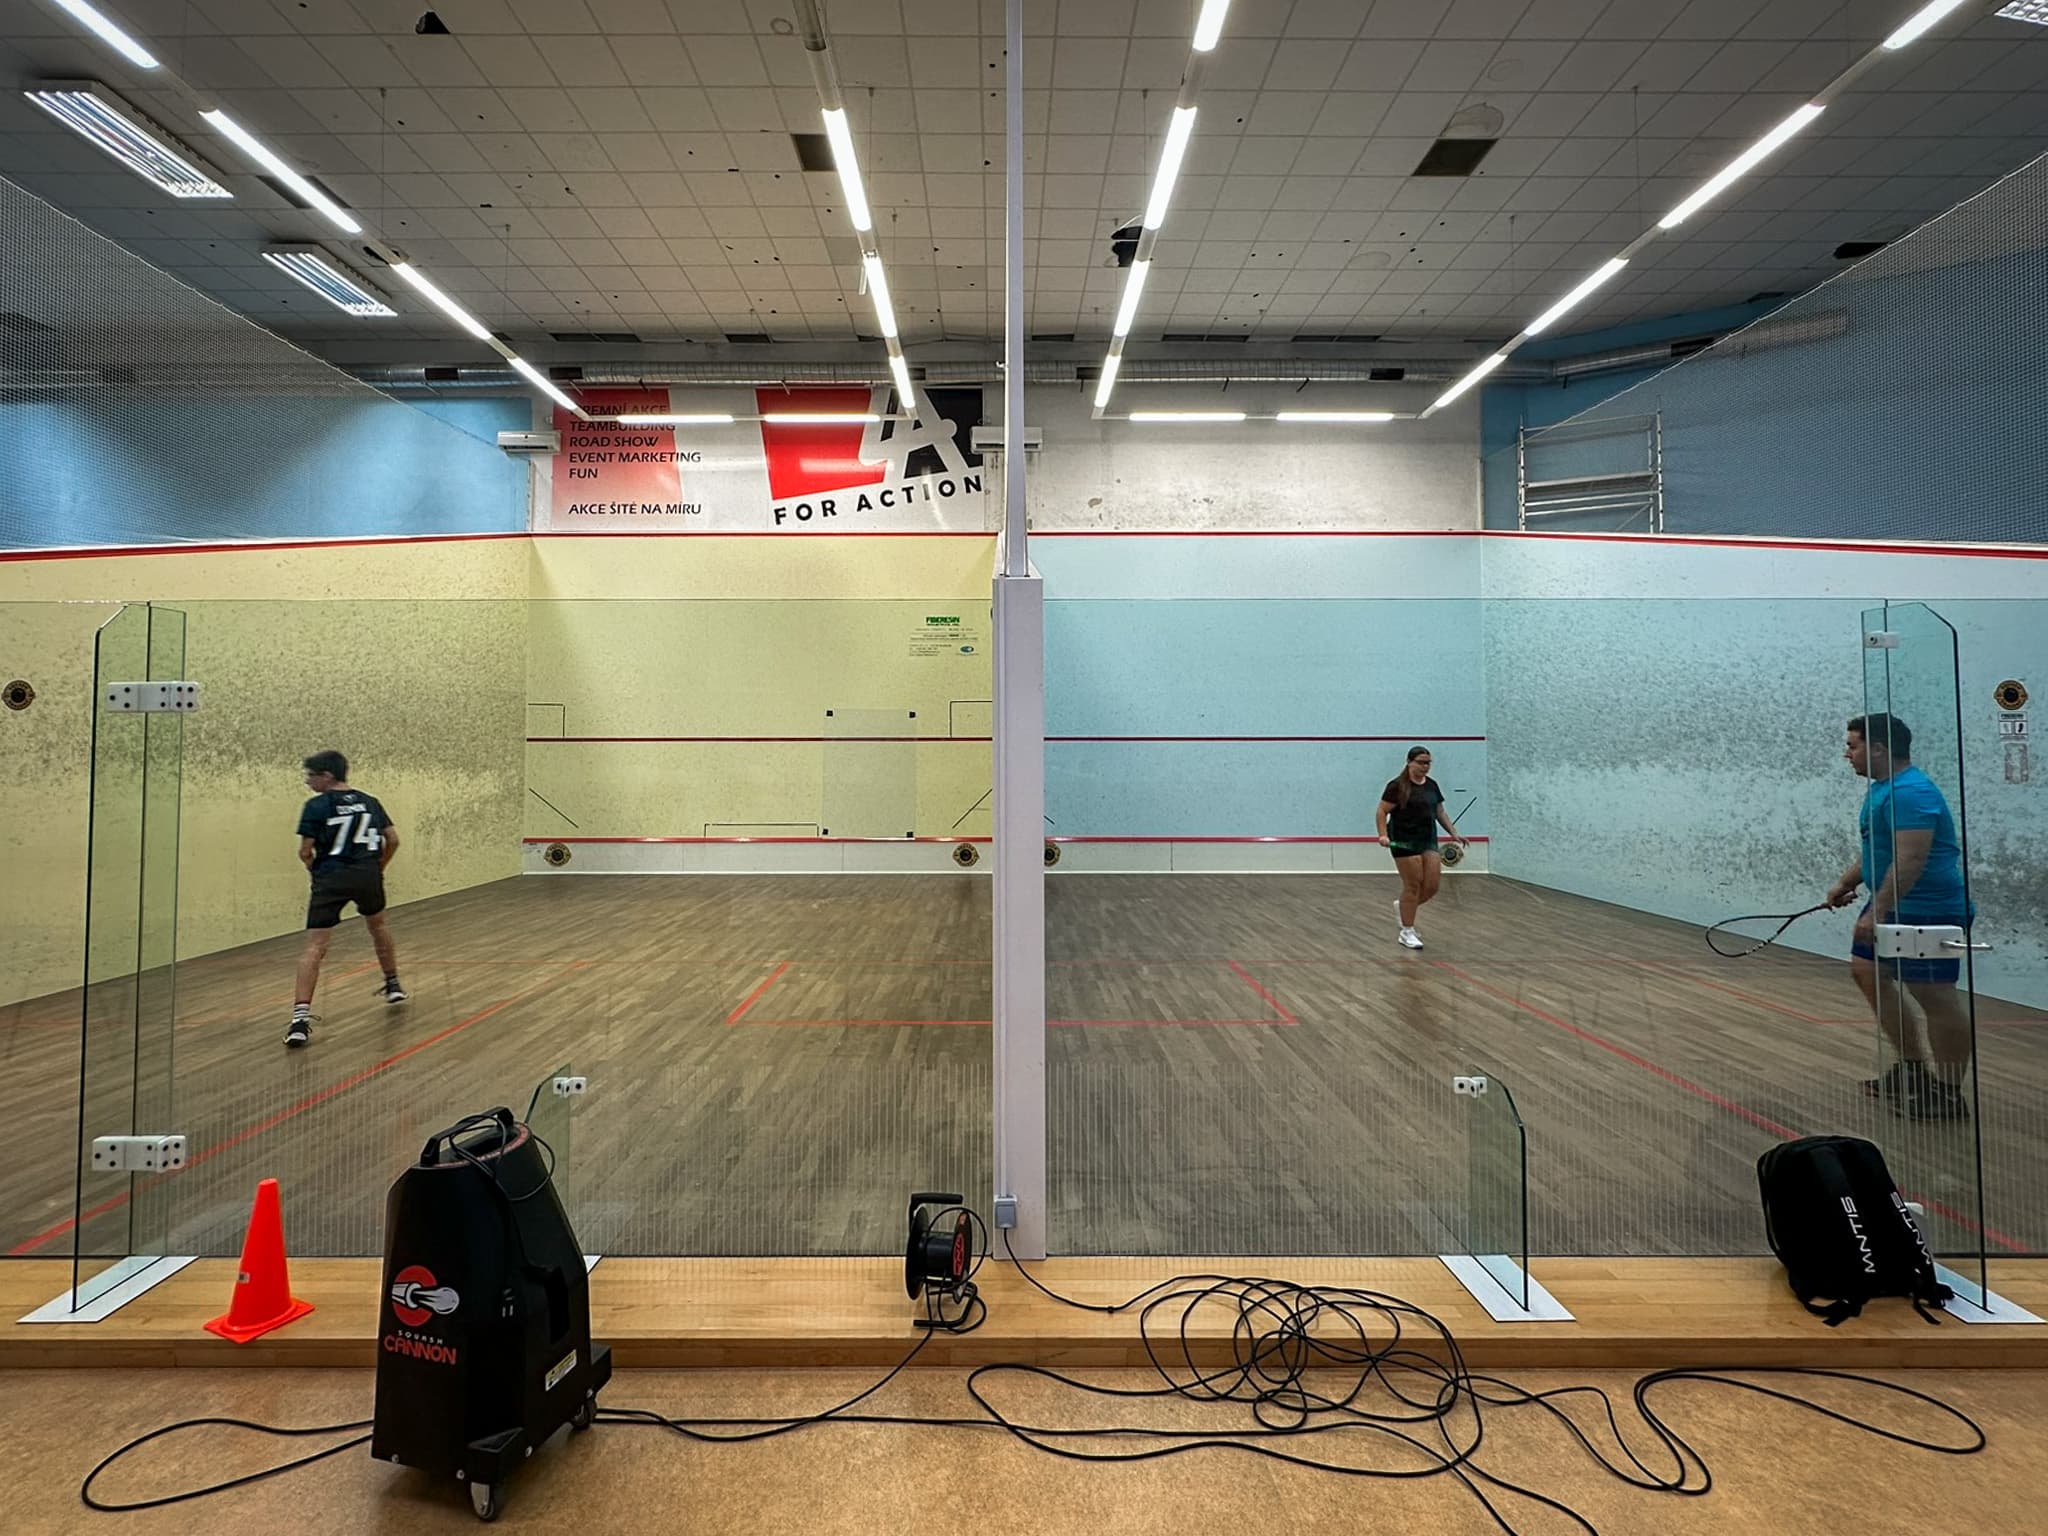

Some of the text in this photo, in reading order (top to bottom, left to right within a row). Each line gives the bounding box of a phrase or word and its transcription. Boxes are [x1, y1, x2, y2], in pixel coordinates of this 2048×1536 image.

[631, 404, 667, 416] AKCE
[570, 420, 676, 431] TEAMBUILDING
[569, 436, 659, 447] ROAD SHOW
[569, 452, 701, 463] EVENT MARKETING
[569, 468, 598, 478] FUN
[774, 475, 983, 525] FOR ACTION
[568, 503, 606, 514] AKCE
[641, 503, 662, 514] NA
[665, 501, 702, 514] MÍRU
[326, 812, 383, 856] 74
[398, 1329, 443, 1345] SQUASH
[383, 1334, 458, 1366] CANNON
